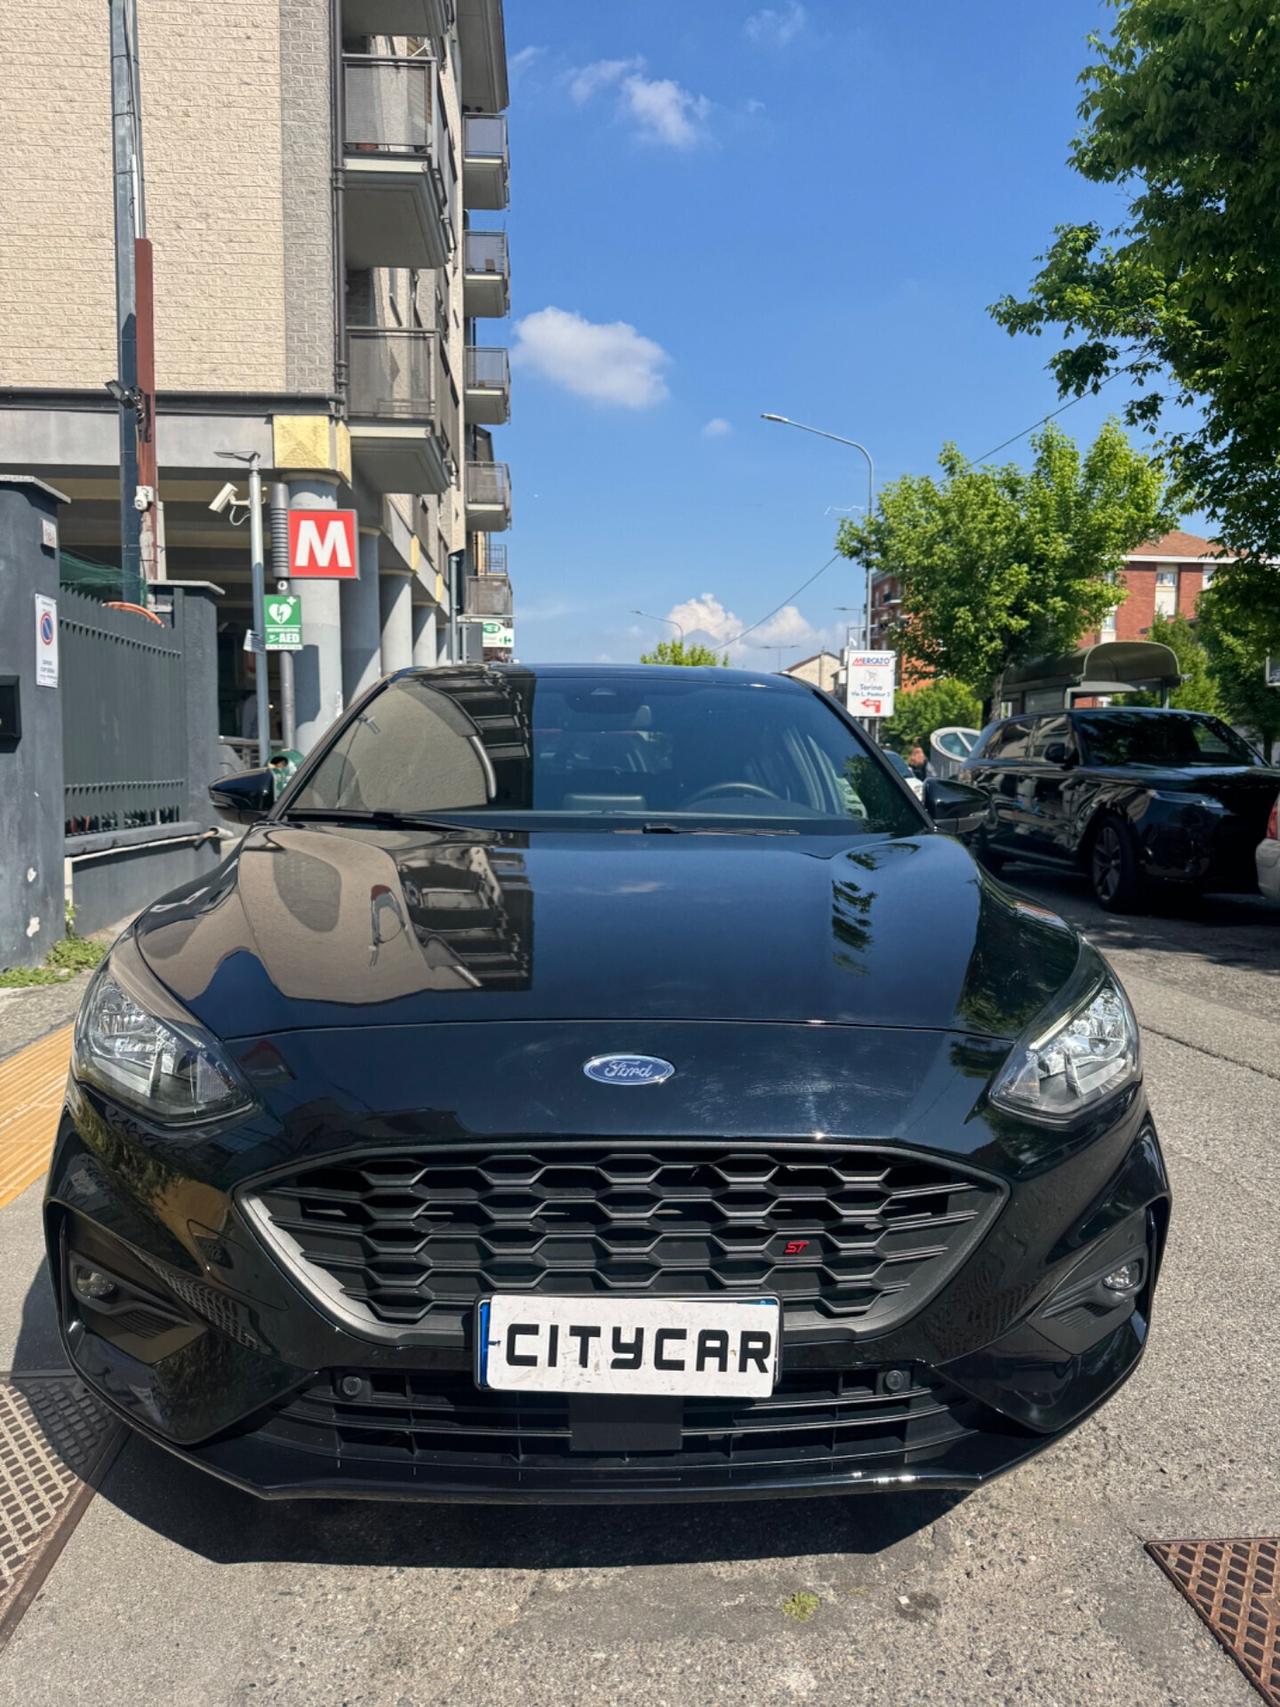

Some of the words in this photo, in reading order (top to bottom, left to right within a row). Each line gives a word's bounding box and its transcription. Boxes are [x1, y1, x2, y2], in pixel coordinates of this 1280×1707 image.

[295, 520, 352, 567] M
[278, 633, 300, 643] AED
[853, 657, 889, 665] MERCATO
[604, 1060, 653, 1077] Ford
[784, 1240, 809, 1254] ST
[506, 1323, 771, 1373] CITYCAR
